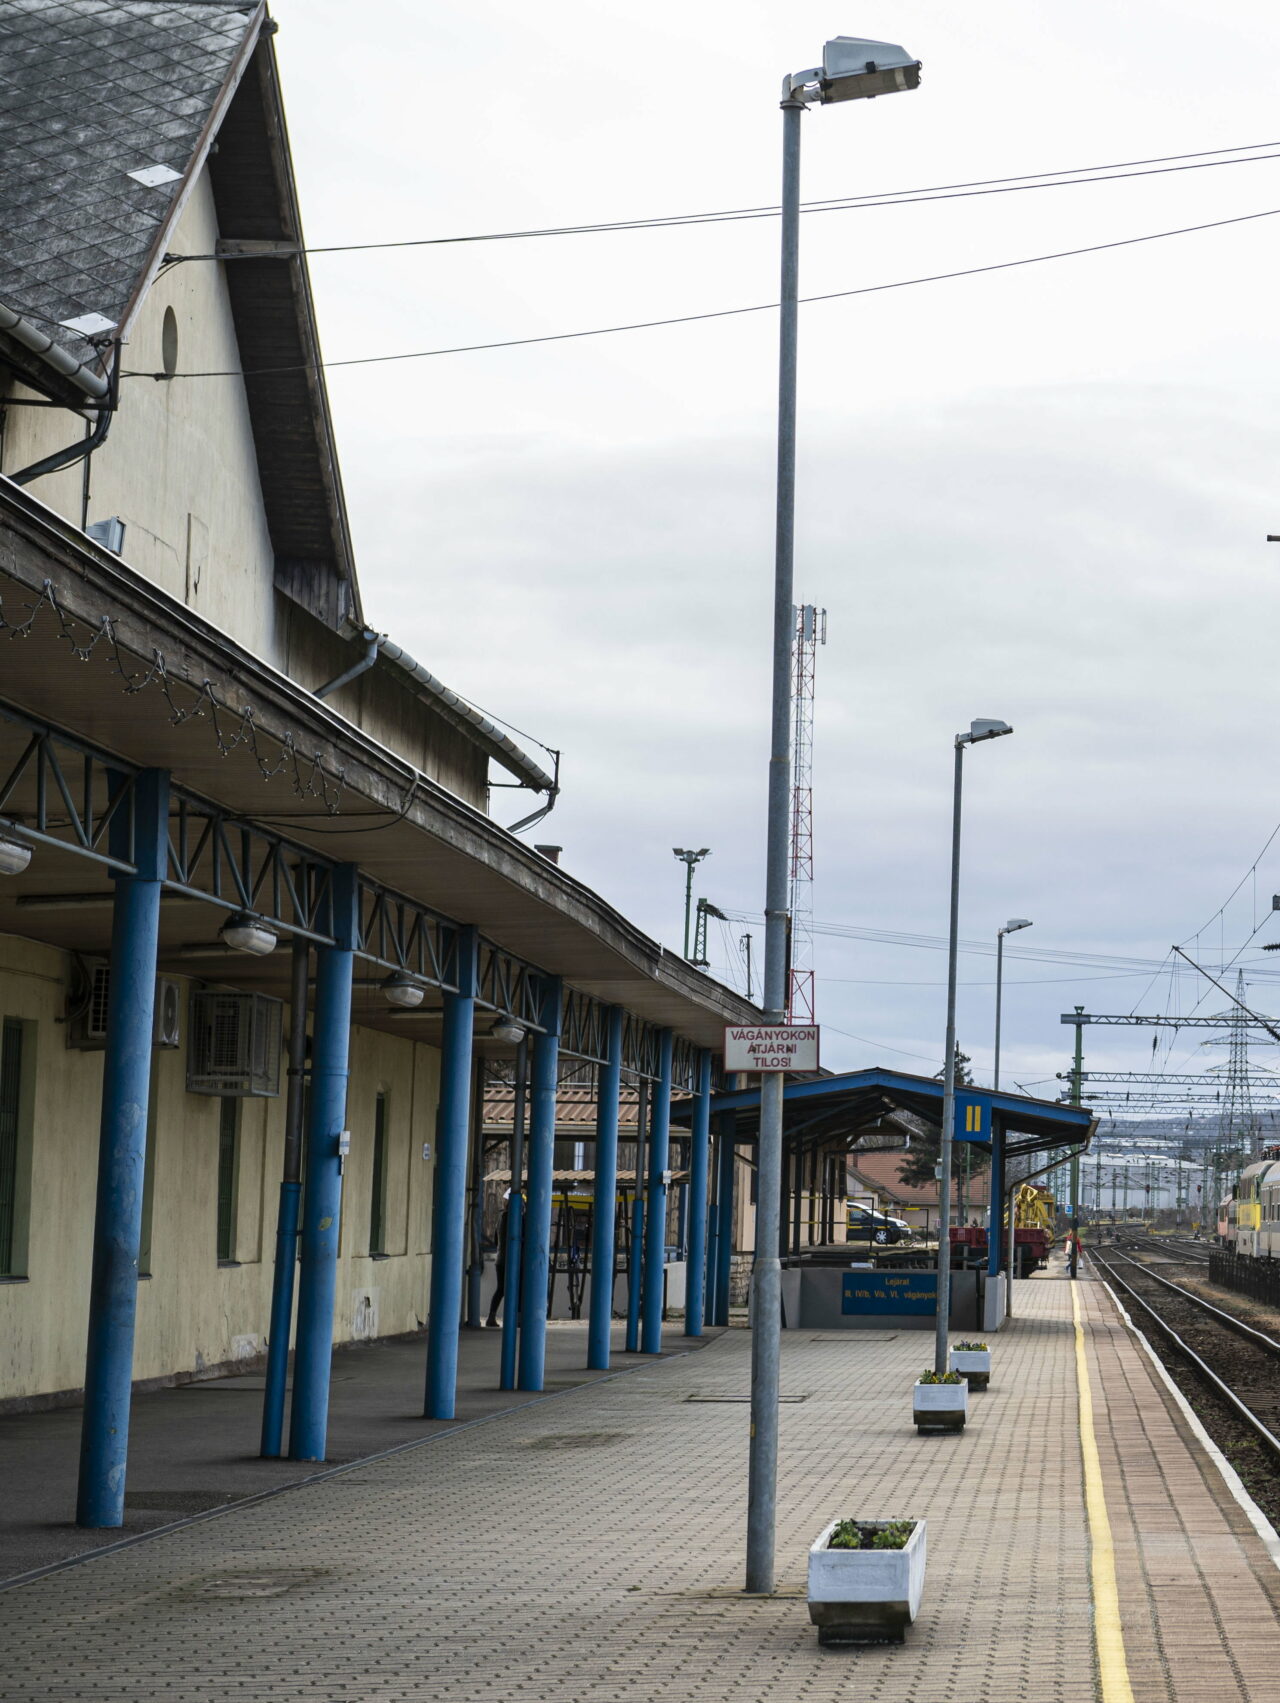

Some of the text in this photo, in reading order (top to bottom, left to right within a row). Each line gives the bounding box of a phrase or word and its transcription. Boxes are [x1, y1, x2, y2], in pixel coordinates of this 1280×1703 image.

[731, 1028, 816, 1041] VÁGÁNYOKON
[747, 1041, 797, 1054] ÁTJÁRNI
[753, 1057, 792, 1068] TILOS!
[965, 1105, 981, 1132] II
